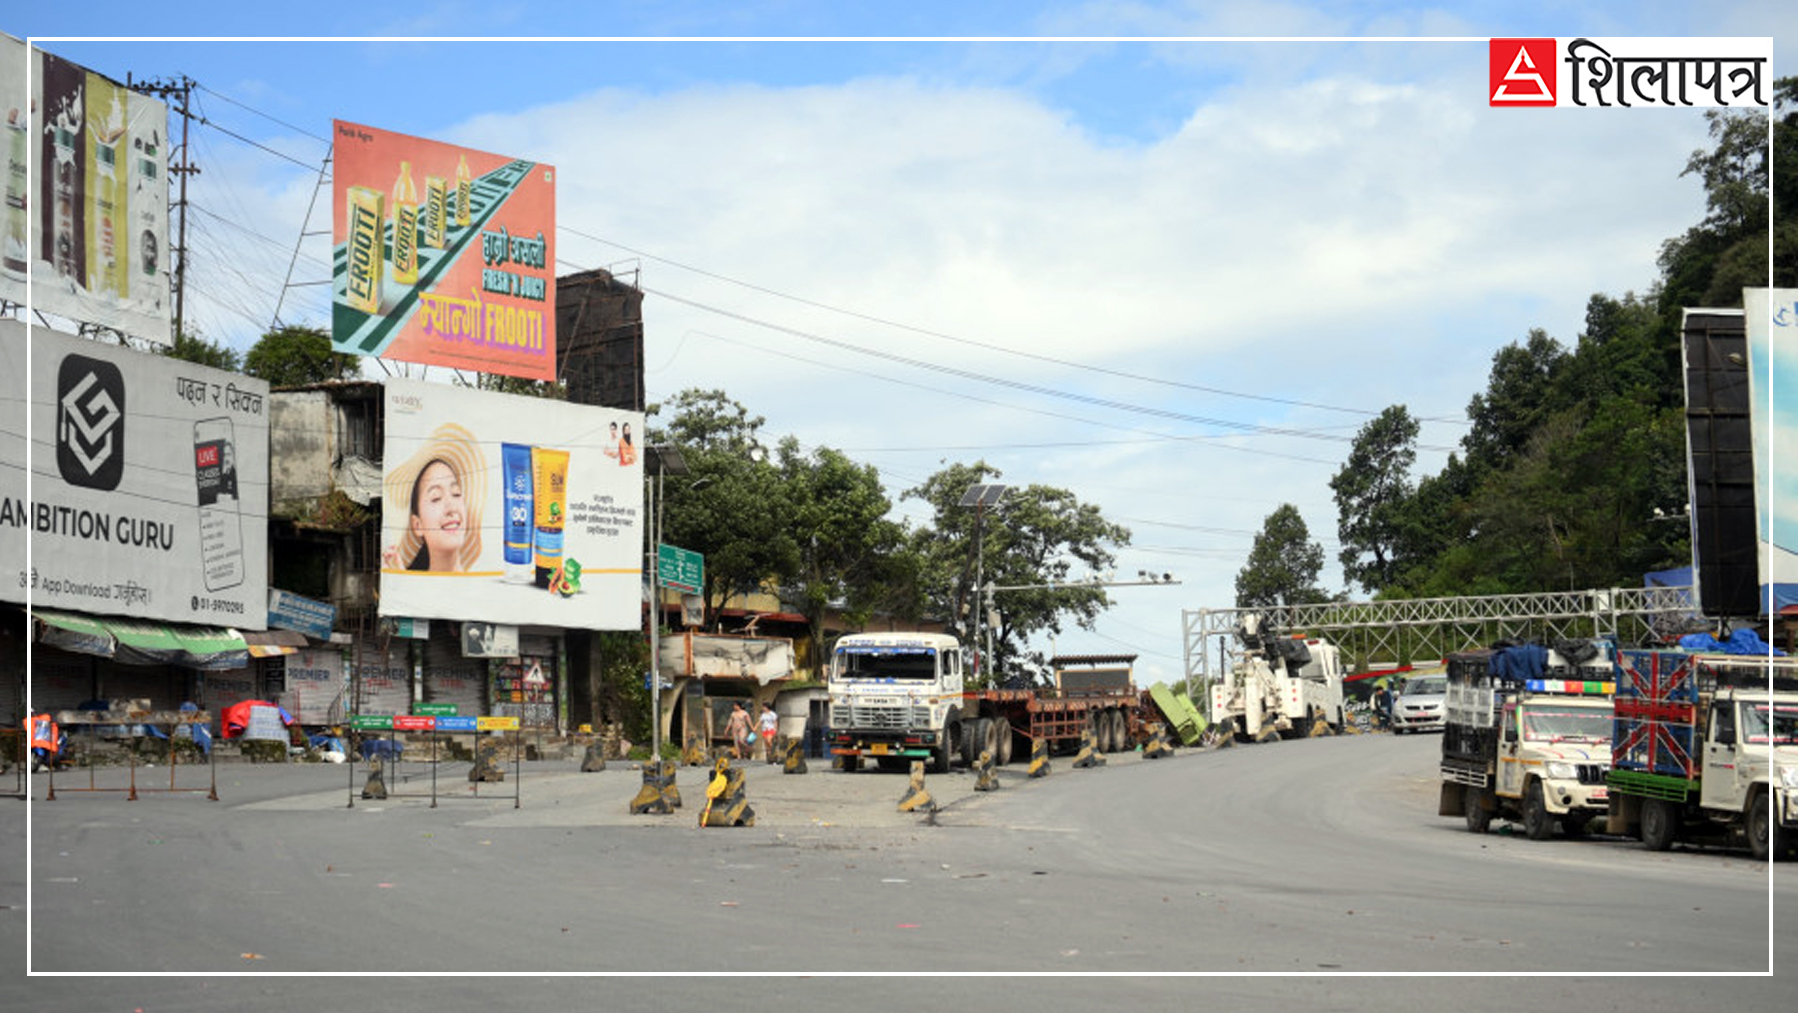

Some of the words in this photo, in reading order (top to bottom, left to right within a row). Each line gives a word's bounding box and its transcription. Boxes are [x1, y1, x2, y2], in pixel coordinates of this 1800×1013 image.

[429, 184, 443, 241] FROOTI
[350, 206, 377, 299] FROOTI
[395, 208, 415, 274] FROOTI
[482, 268, 511, 295] FRESH
[521, 275, 546, 301] JUICY
[486, 303, 543, 350] FROOTI
[199, 450, 216, 463] LIVE
[0, 498, 109, 542] AMBITION
[116, 516, 174, 551] GURU
[42, 577, 62, 597] App
[63, 579, 111, 599] Download
[288, 667, 330, 681] PREMIER
